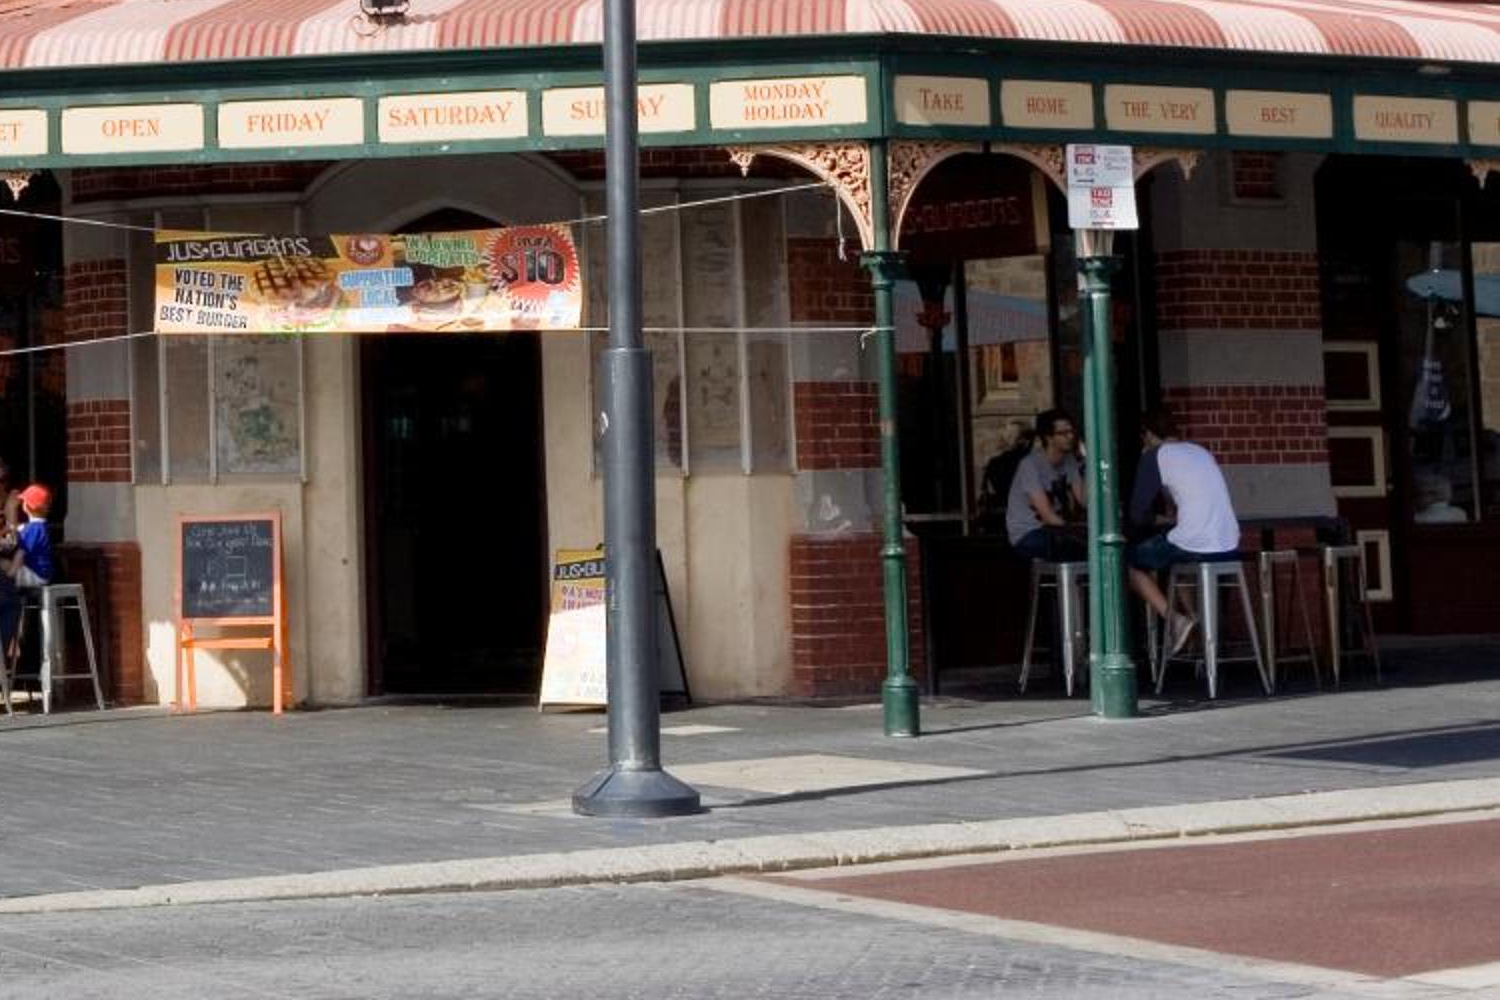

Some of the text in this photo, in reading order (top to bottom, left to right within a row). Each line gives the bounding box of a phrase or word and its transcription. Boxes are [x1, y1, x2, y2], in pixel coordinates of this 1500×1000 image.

[743, 80, 828, 100] MONDAY
[101, 118, 161, 138] OPEN
[246, 108, 331, 134] FRIDAY
[388, 101, 513, 128] SATURDAY
[569, 94, 665, 121] SUAY
[743, 100, 832, 121] HOLIDAY
[919, 87, 1436, 130] TAKE HOME THE VERY BEST QUALITY
[501, 247, 565, 284] $10
[174, 268, 245, 292] VOTED THE
[174, 288, 238, 310] NATION'S
[159, 305, 248, 330] BEST BURGER
